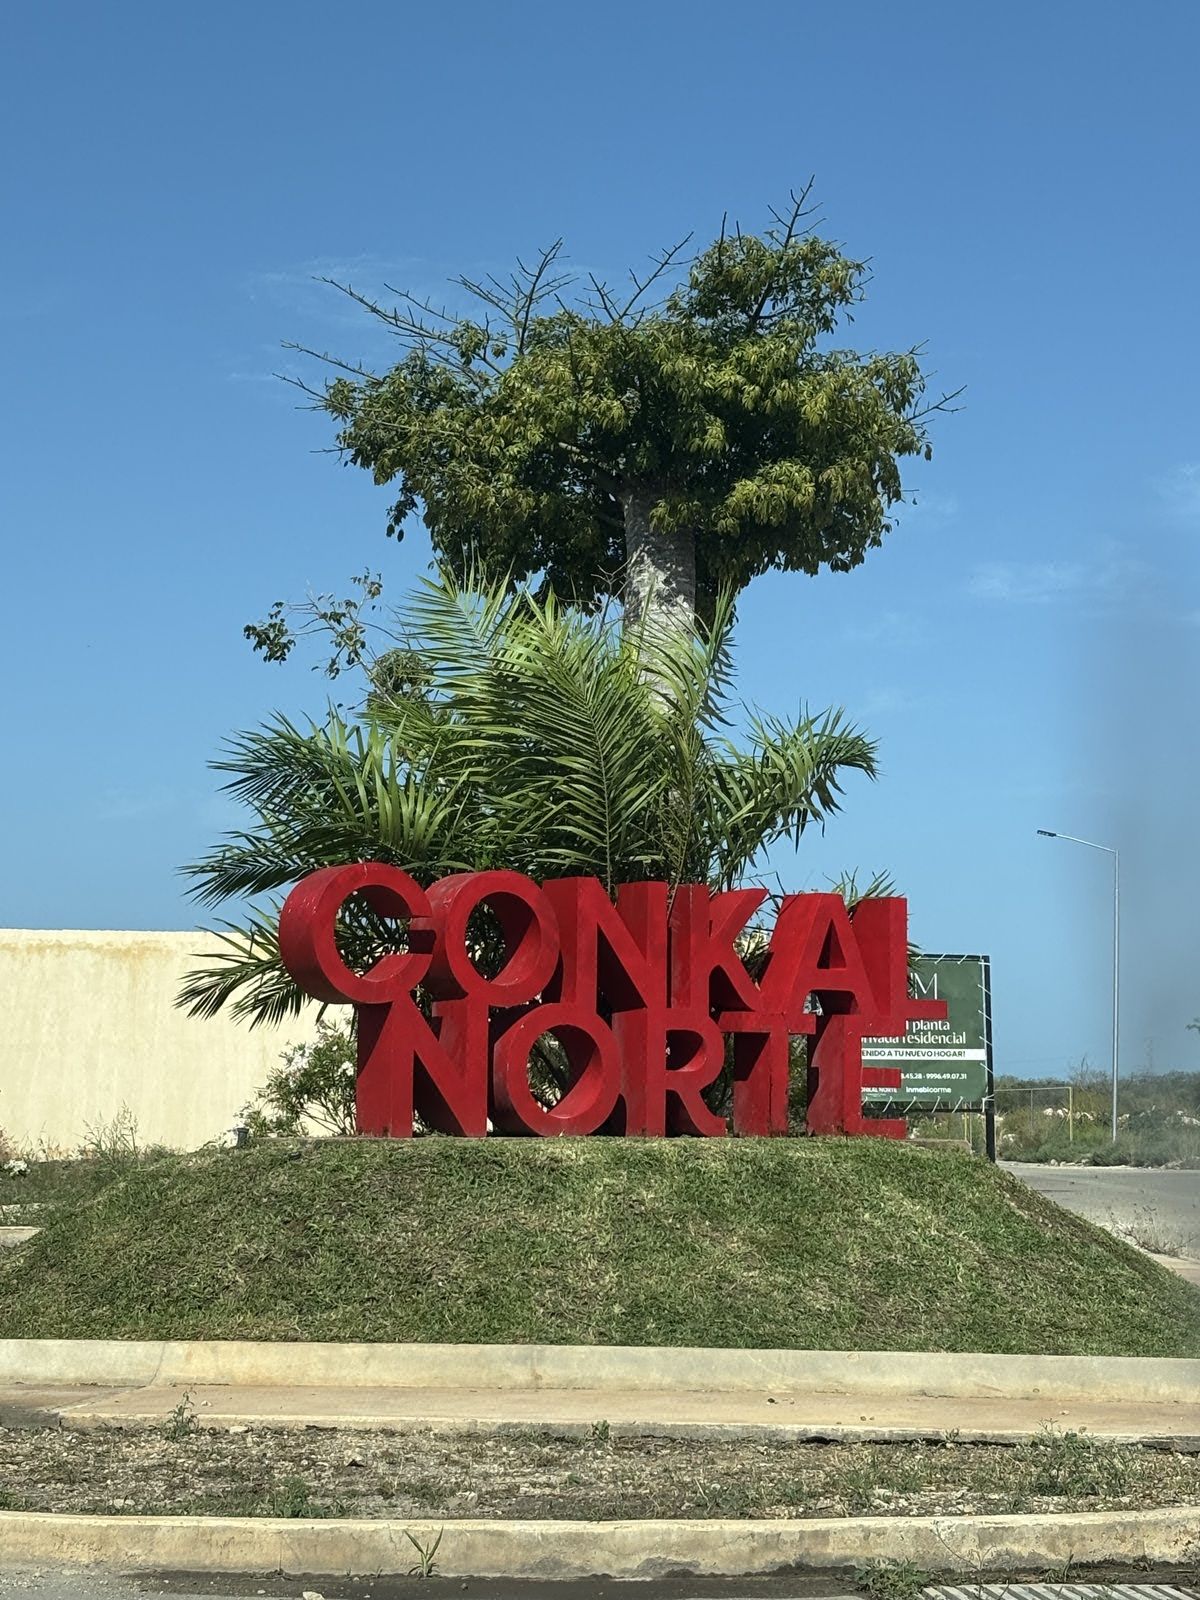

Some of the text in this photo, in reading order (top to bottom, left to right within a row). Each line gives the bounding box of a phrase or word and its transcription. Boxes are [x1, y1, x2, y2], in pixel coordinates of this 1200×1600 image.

[279, 862, 947, 1020] CONKAL
[912, 1019, 950, 1033] planta
[903, 1031, 967, 1044] residencial
[887, 1050, 893, 1058] A
[894, 1050, 904, 1058] TU
[905, 1050, 933, 1058] NUEVO
[934, 1050, 966, 1059] HOGAR!
[356, 1000, 907, 1138] NORTE
